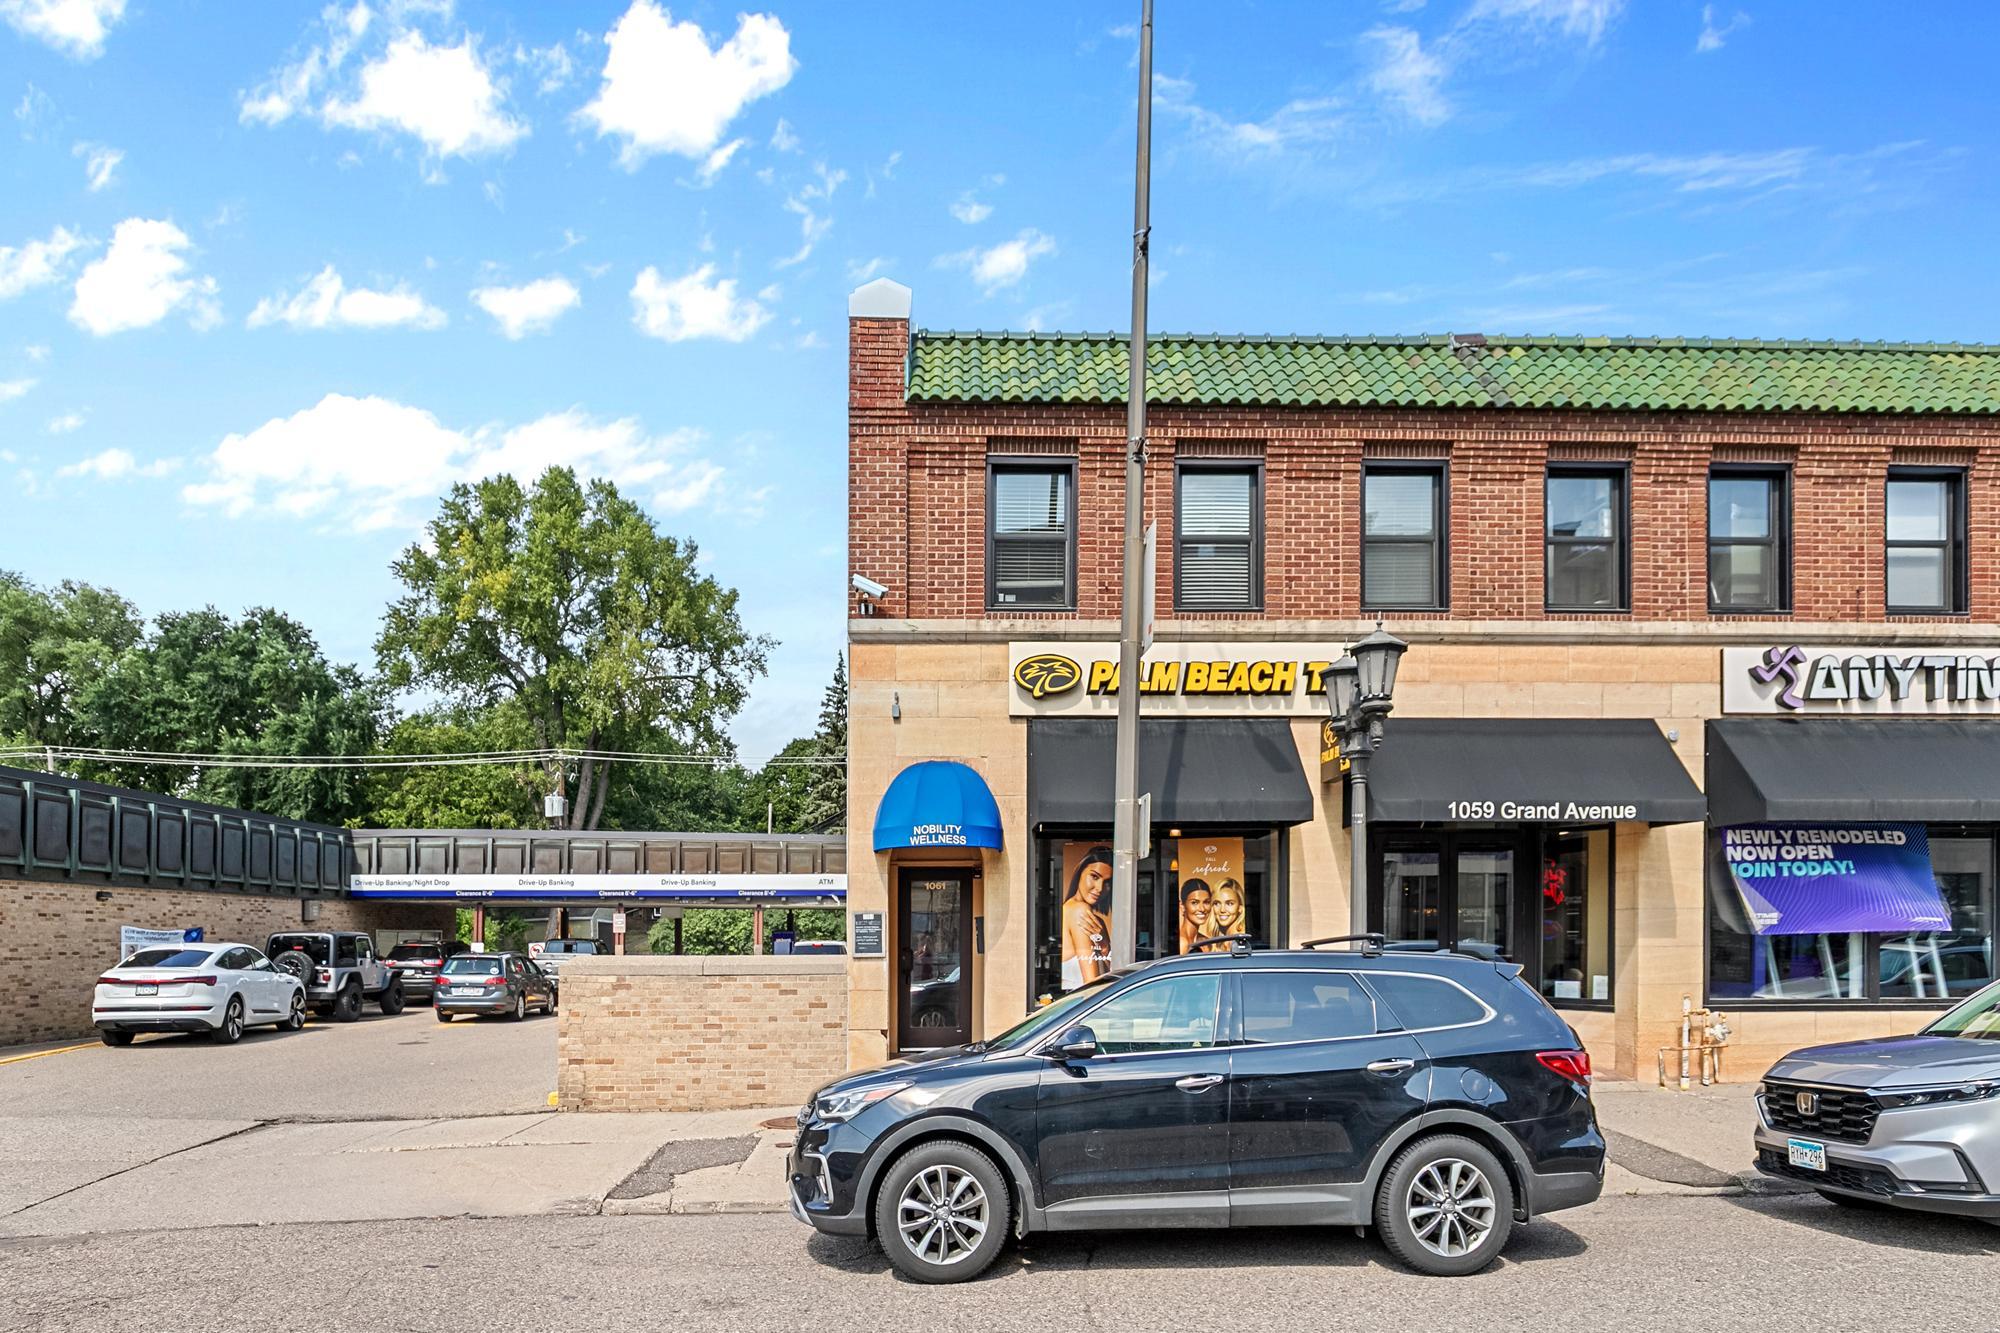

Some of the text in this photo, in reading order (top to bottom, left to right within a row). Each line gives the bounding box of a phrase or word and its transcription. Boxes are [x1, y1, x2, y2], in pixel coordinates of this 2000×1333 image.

[1183, 660, 1298, 696] BEACH
[1304, 661, 1330, 696] T
[1447, 801, 1637, 819] 1059 Grand Avenue
[913, 824, 962, 835] NOBILITY
[909, 834, 967, 846] WELLNESS
[1726, 829, 1906, 846] NEWLY REMODELED
[1726, 844, 1834, 861] NOW OPEN
[1778, 860, 1857, 878] TODAY!
[354, 879, 384, 887] Drive-Up
[434, 879, 450, 887] Drop
[548, 879, 575, 887] Banking
[660, 878, 717, 887] Drive-Up Banking
[924, 881, 947, 891] 1061
